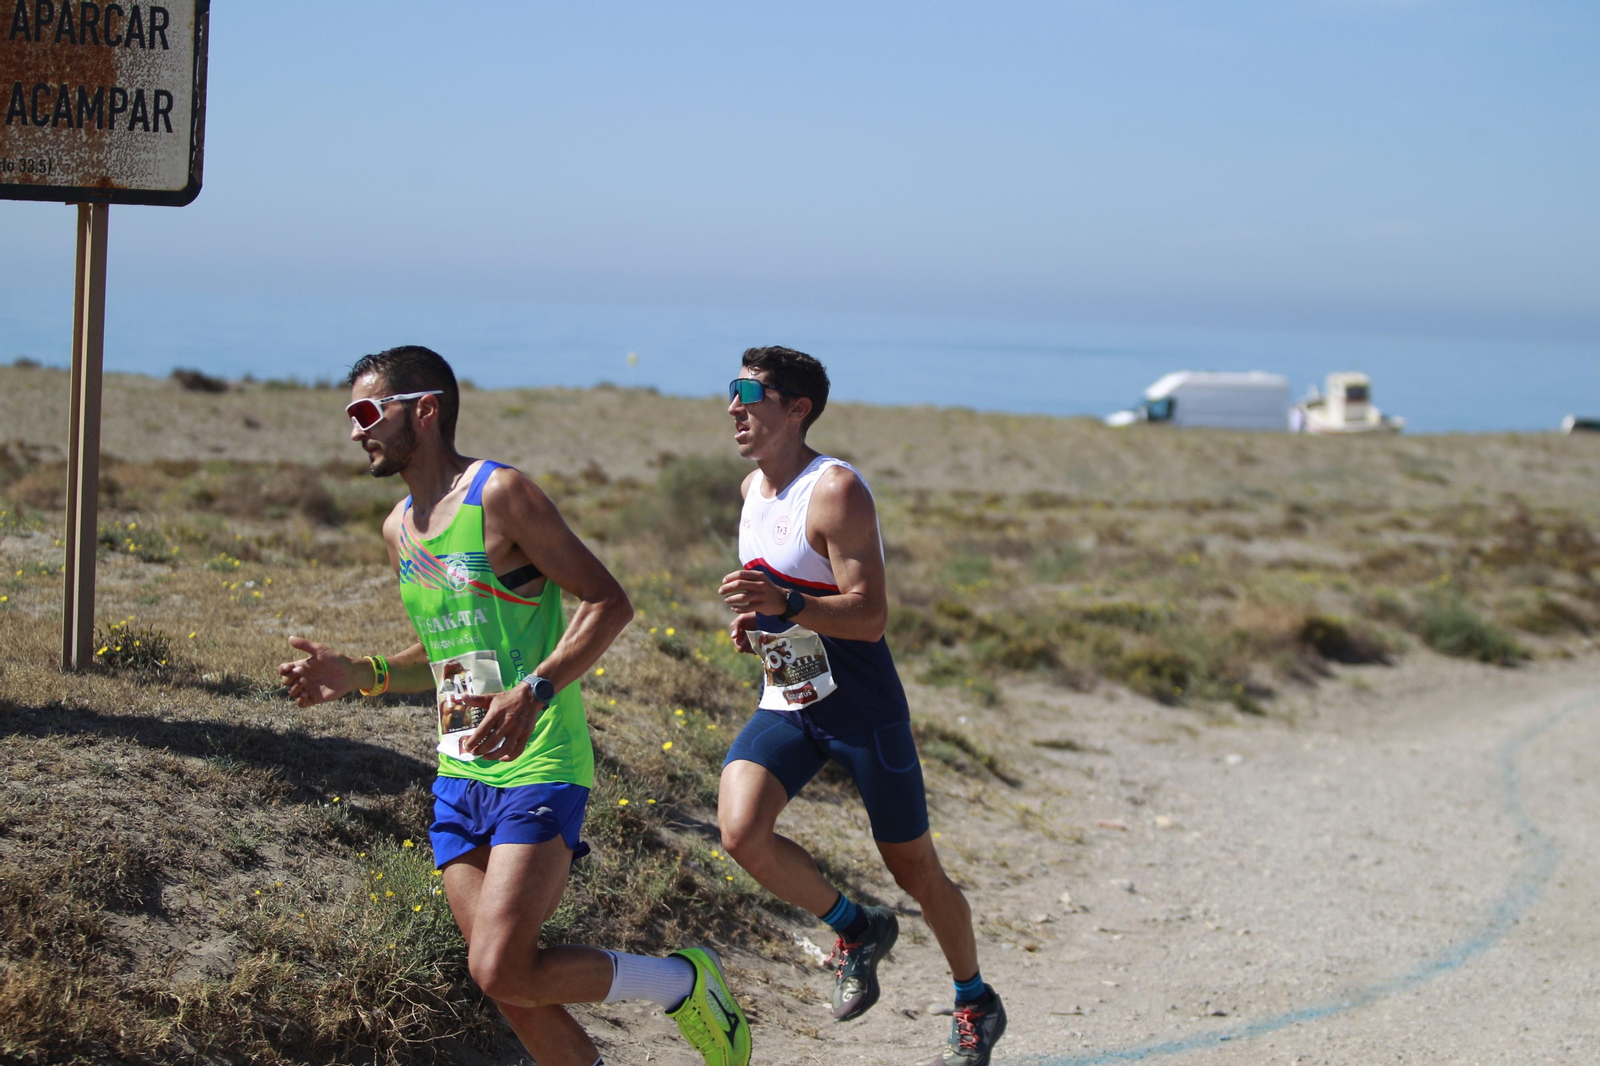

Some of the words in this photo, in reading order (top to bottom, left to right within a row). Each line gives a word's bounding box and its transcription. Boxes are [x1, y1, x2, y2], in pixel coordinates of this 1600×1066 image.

[9, 0, 170, 50] APARCAR
[6, 82, 173, 133] ACAMPAR
[2, 157, 14, 172] lo
[425, 608, 489, 633] SAKATA
